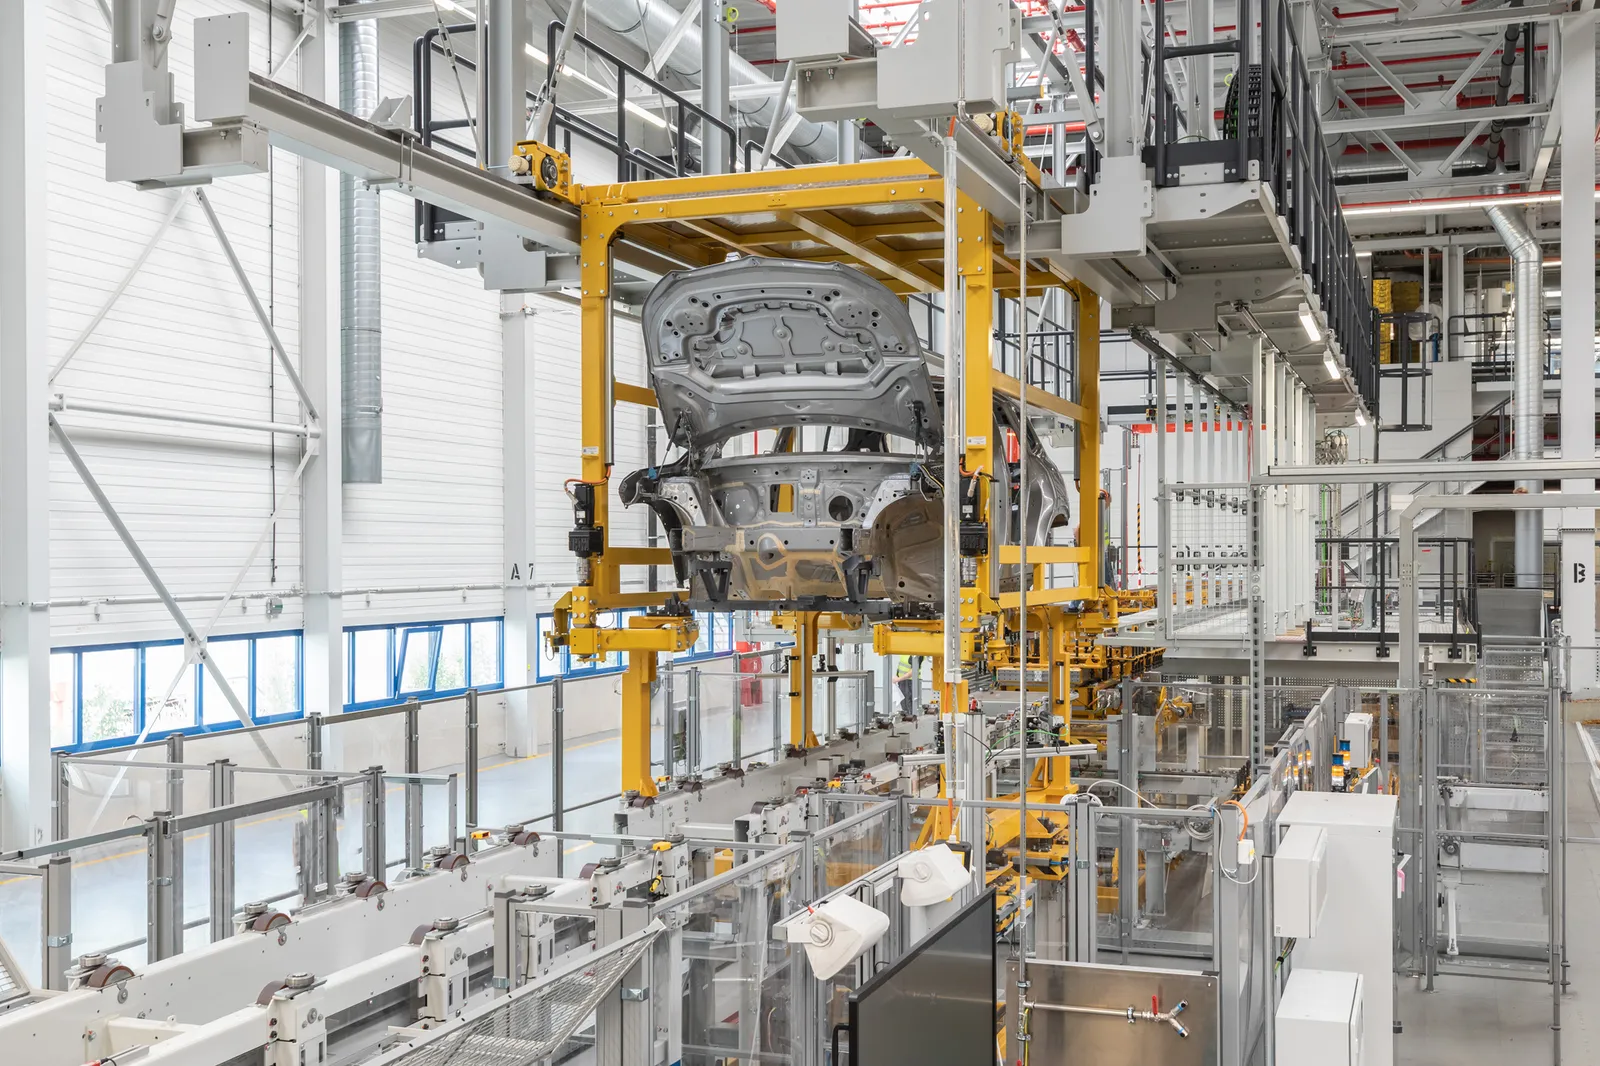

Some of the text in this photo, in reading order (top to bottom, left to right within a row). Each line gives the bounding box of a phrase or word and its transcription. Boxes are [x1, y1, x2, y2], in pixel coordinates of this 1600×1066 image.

[510, 563, 534, 580] A 7
[1573, 563, 1586, 583] B
